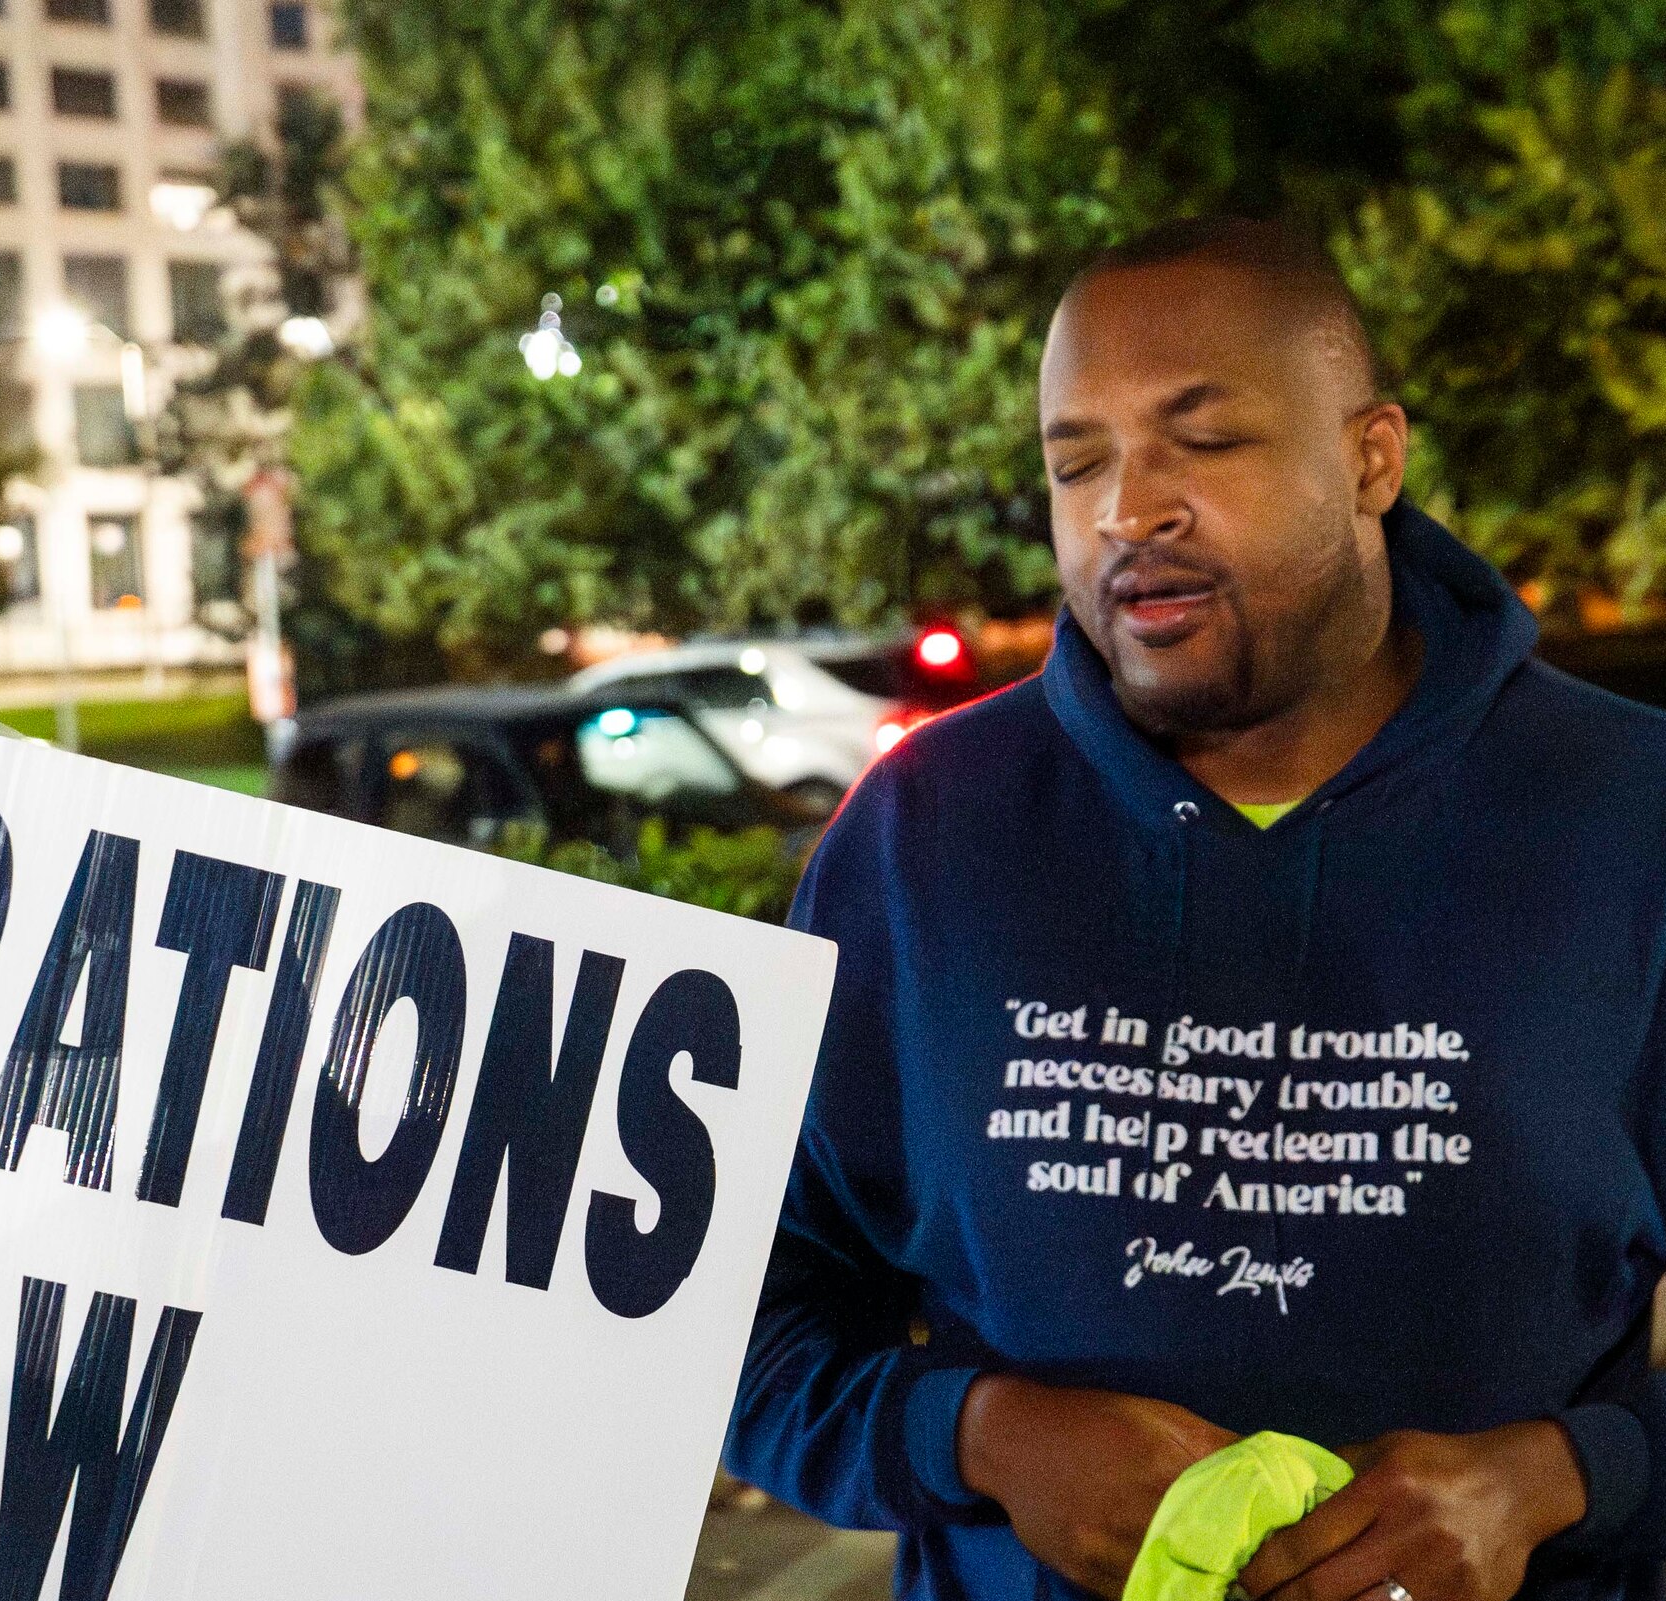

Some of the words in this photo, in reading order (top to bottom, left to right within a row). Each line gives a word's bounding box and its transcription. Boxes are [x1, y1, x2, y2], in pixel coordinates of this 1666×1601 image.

[1101, 1007, 1148, 1047] in
[1161, 1015, 1276, 1066] good
[1289, 1022, 1471, 1063] trouble,
[1004, 1058, 1263, 1120] neccessary
[1278, 1071, 1459, 1114] trouble,
[986, 1100, 1071, 1140] and
[1083, 1103, 1189, 1163] help
[1199, 1122, 1379, 1163] redeem
[1391, 1122, 1472, 1165] the
[1026, 1157, 1122, 1197] soul
[1132, 1162, 1192, 1203] of
[1123, 1236, 1215, 1289] John
